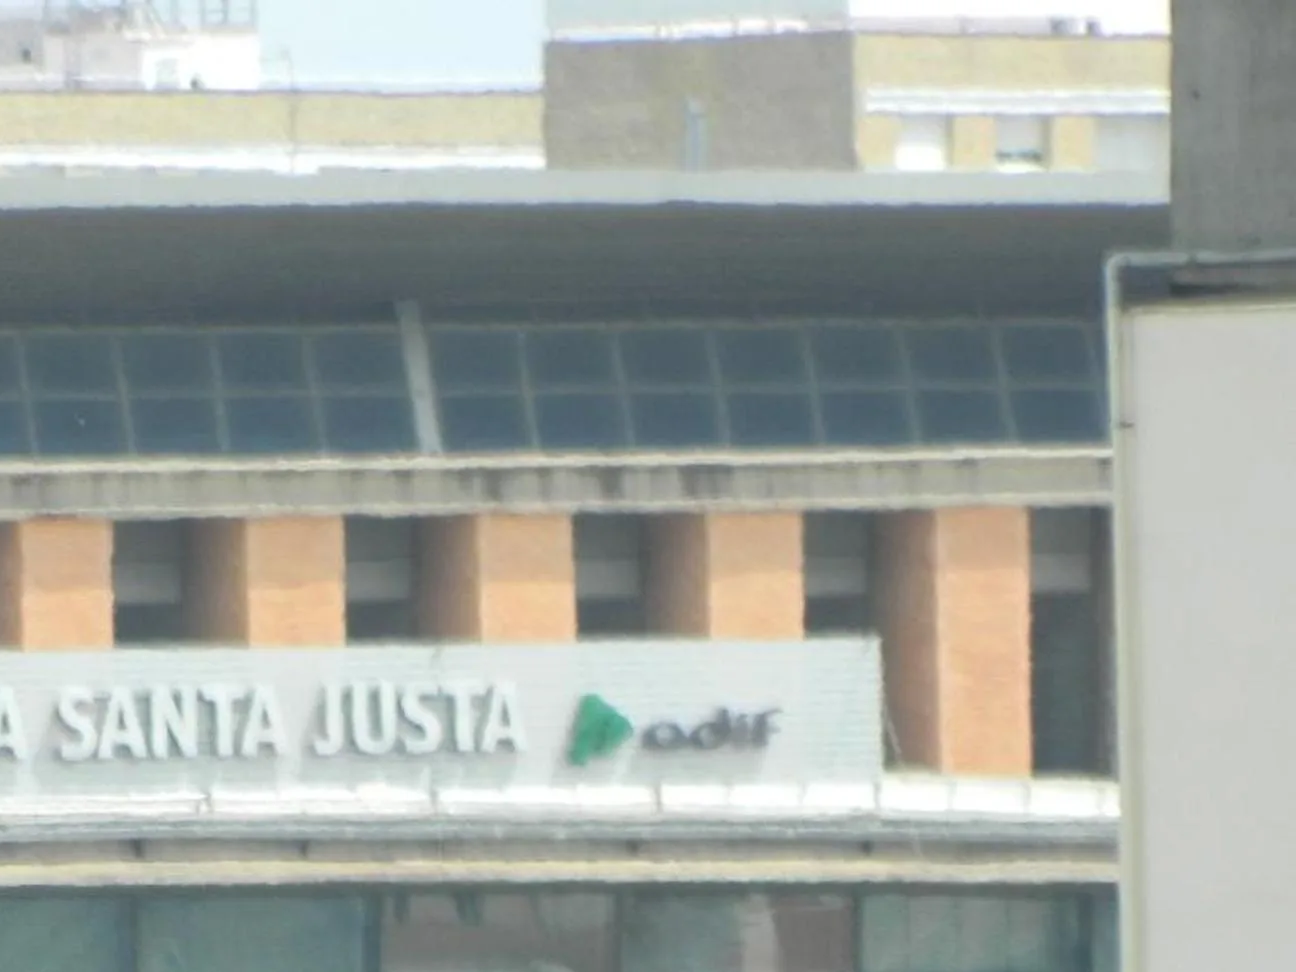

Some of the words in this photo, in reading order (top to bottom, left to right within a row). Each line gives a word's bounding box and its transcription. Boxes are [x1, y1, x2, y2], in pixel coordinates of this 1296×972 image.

[56, 684, 280, 763] SANTA
[314, 677, 526, 757] JUSTA
[641, 706, 781, 752] adif
